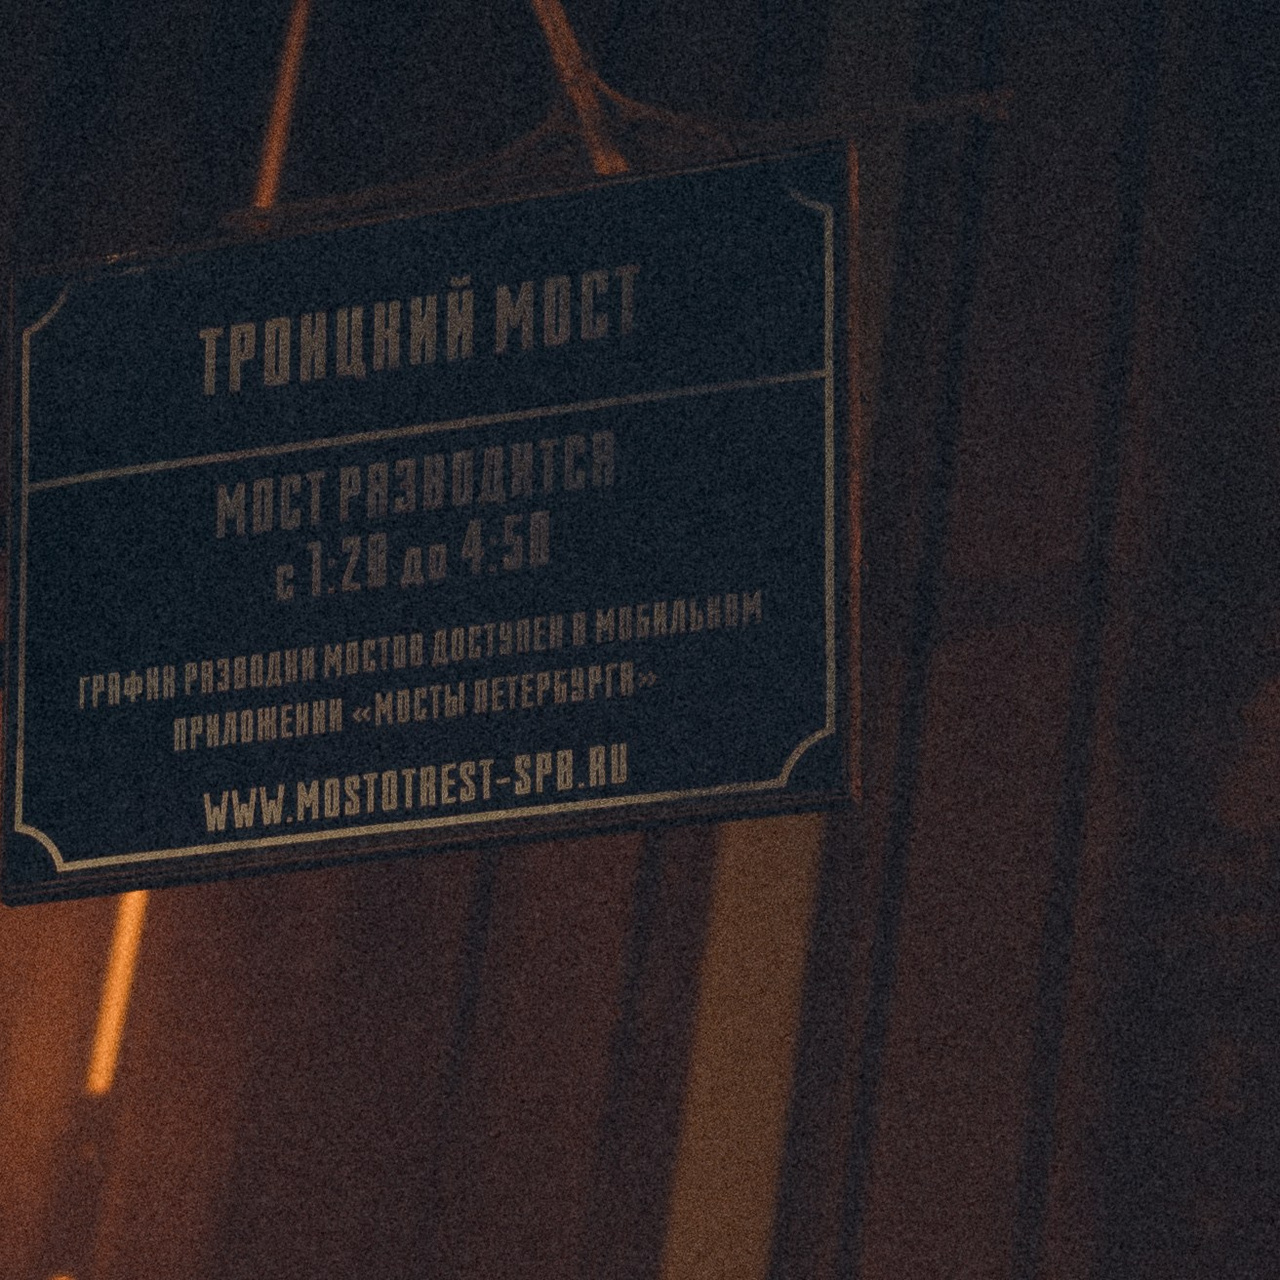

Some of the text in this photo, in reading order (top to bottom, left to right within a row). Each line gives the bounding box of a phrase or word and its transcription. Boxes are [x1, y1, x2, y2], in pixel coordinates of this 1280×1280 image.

[199, 264, 641, 396] ТРОИЦКИЙ МОСТ
[215, 429, 616, 539] МОСТ РАЗВОДИТСЯ
[307, 531, 388, 598] 1:20
[401, 543, 448, 589] до
[461, 509, 551, 575] 4:50
[78, 664, 176, 711] ГРАФИК
[323, 632, 424, 679] МОСТОВ
[431, 613, 565, 667] ДОСТУПЕН
[571, 611, 587, 647] В
[595, 589, 764, 644] МОБИЛЬНОМ
[172, 660, 659, 752] ПРИЛОЖЕНИИ «МОСТЫ ПЕТЕРБУРГА»
[202, 742, 629, 833] WWW.MOSTOTREST-SPB.RU
